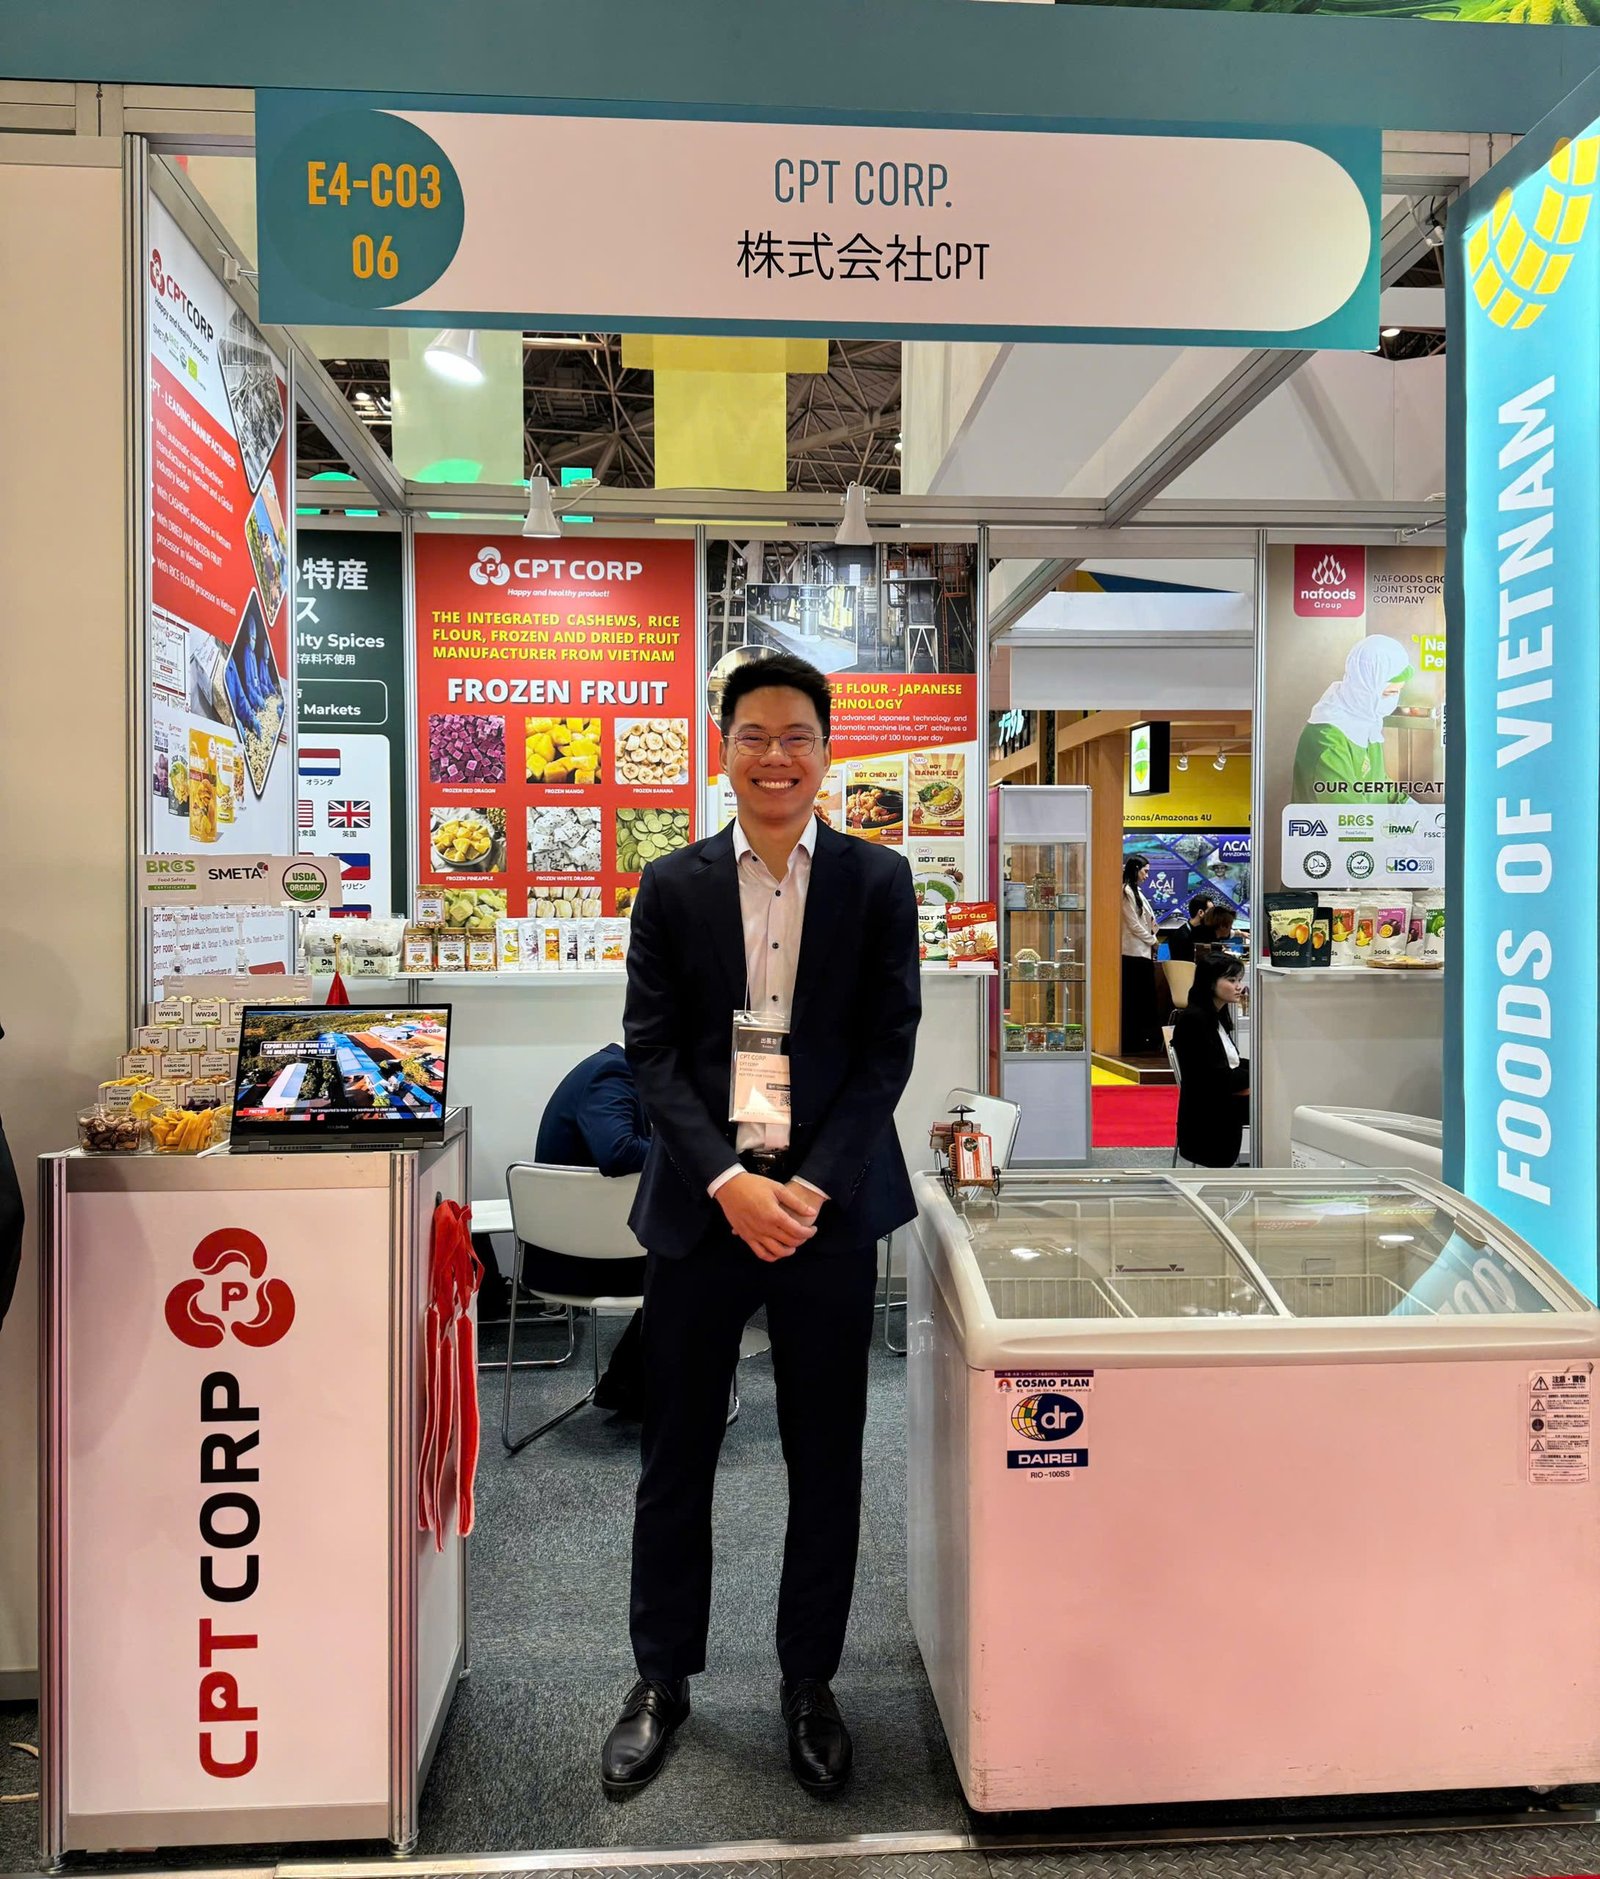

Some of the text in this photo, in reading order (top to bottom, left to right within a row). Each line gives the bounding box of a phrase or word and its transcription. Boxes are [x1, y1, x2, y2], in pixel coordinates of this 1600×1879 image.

[307, 161, 441, 209] E4-C03
[775, 158, 952, 208] CPT CORP.
[352, 234, 399, 280] 06
[736, 230, 990, 282] 株式会社CPT
[165, 391, 191, 427] LEADING
[1373, 575, 1424, 584] NAFOODS
[507, 588, 610, 599] Happy and healthy product!
[1300, 587, 1357, 600] nafoods
[1373, 585, 1442, 595] JOINT STOCK
[1313, 601, 1343, 609] Group
[1373, 595, 1426, 605] COMPANY
[432, 611, 681, 629] THE INTEGRATED CASHEWS, RICE
[327, 633, 386, 651] Spices
[432, 629, 680, 645] FLOUR, FROZEN AND DRIED FRUIT
[433, 647, 676, 663] MANUFACTURER FROM VIETNAM
[447, 678, 668, 705] FROZEN FRUIT
[846, 683, 962, 697] FLOUR JAPANESE
[304, 703, 361, 716] Markets
[878, 714, 910, 723] Japanese
[913, 714, 952, 723] technology
[849, 734, 880, 742] capacity
[902, 734, 918, 742] tons
[930, 734, 944, 742] day
[1314, 781, 1348, 793] OUR
[1496, 375, 1556, 1206] FOODS OF VIETNAM
[1338, 814, 1374, 827] BRCS
[342, 830, 357, 839] 英国
[1288, 819, 1329, 837] FDA
[146, 860, 196, 873] BRCS
[1394, 859, 1419, 872] ISO
[208, 867, 264, 881] SMETA
[292, 872, 317, 882] USDA
[289, 884, 321, 893] ORGANIC
[1015, 1378, 1090, 1388] COSMO PLAN
[1041, 1405, 1077, 1430] dr
[1018, 1452, 1078, 1465] DAIREI
